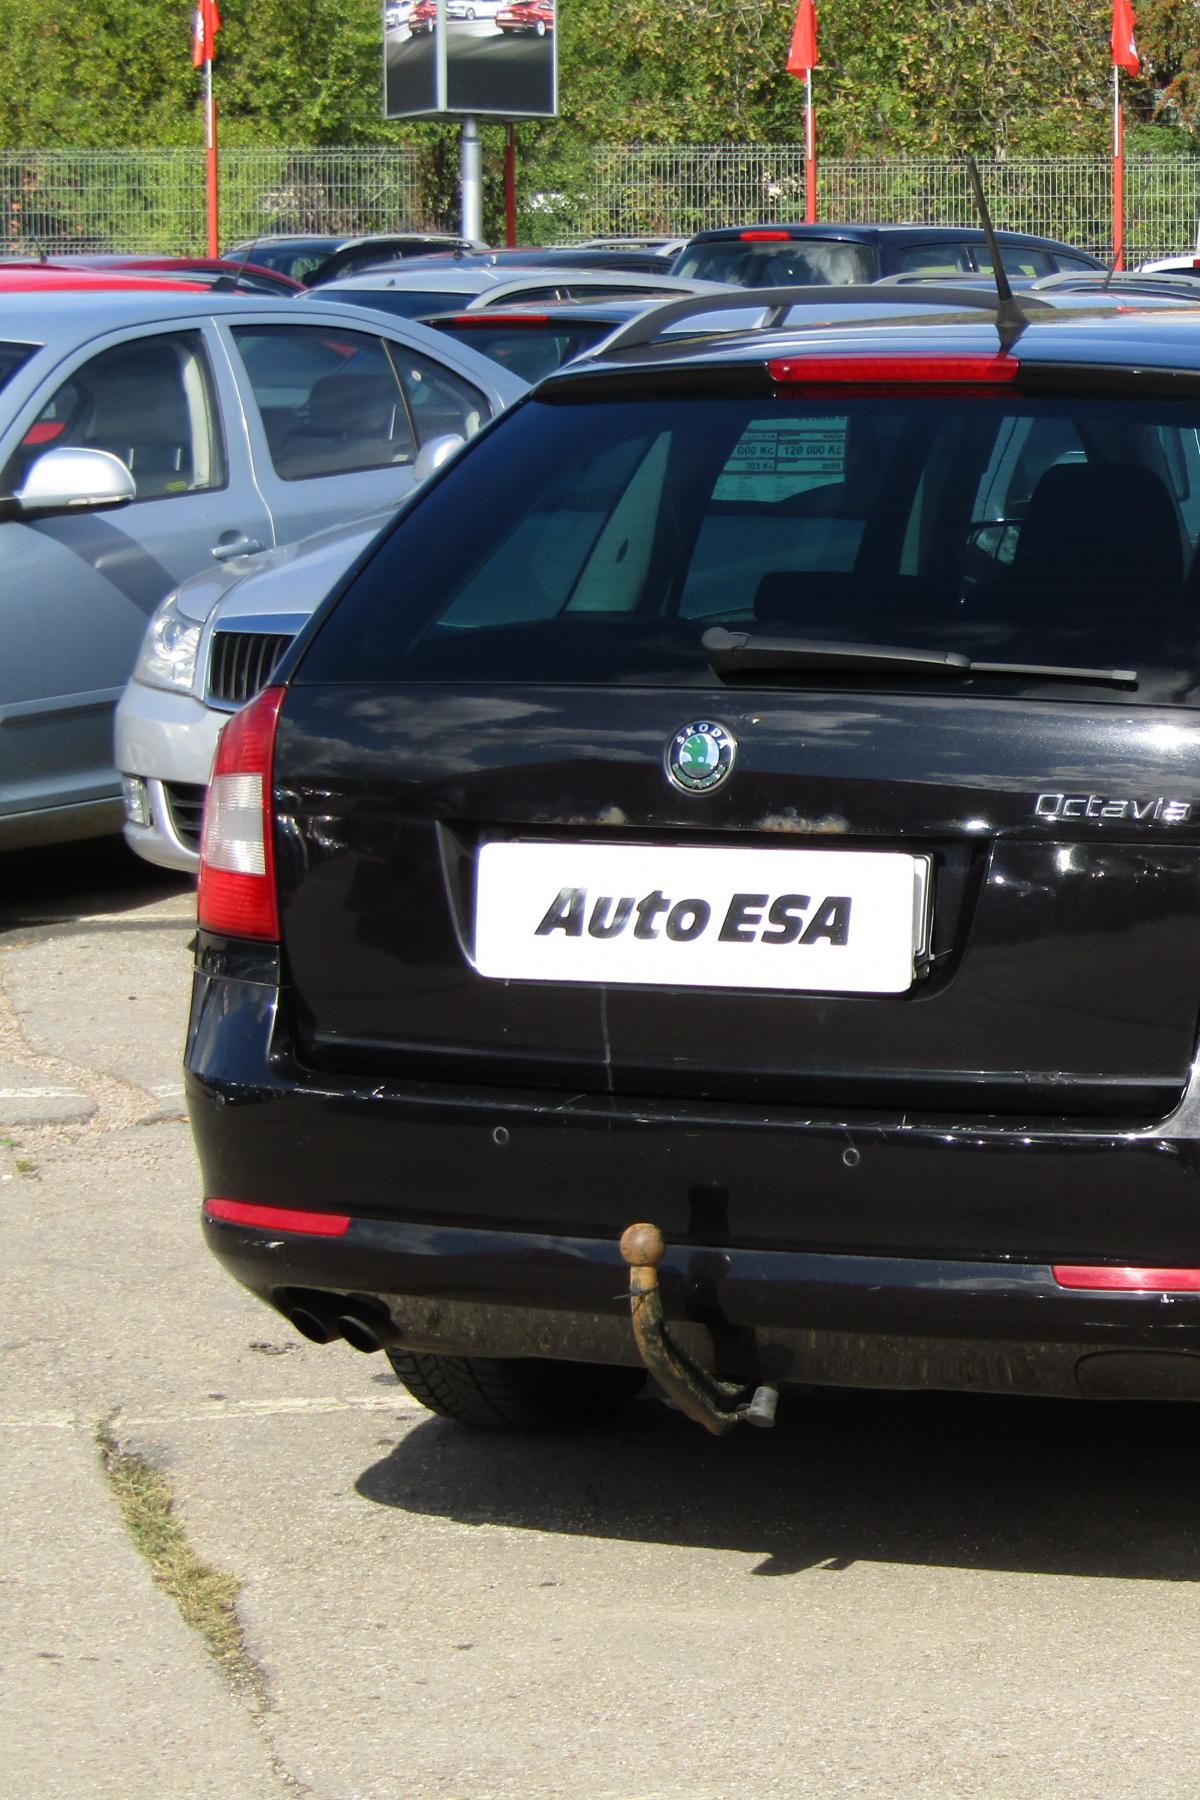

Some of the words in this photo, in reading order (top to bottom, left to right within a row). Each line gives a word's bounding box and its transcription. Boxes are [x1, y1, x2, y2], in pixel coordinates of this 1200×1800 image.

[784, 446, 803, 456] 120
[1035, 794, 1192, 821] Octavia
[534, 887, 711, 942] Auto
[718, 893, 853, 946] ESA
